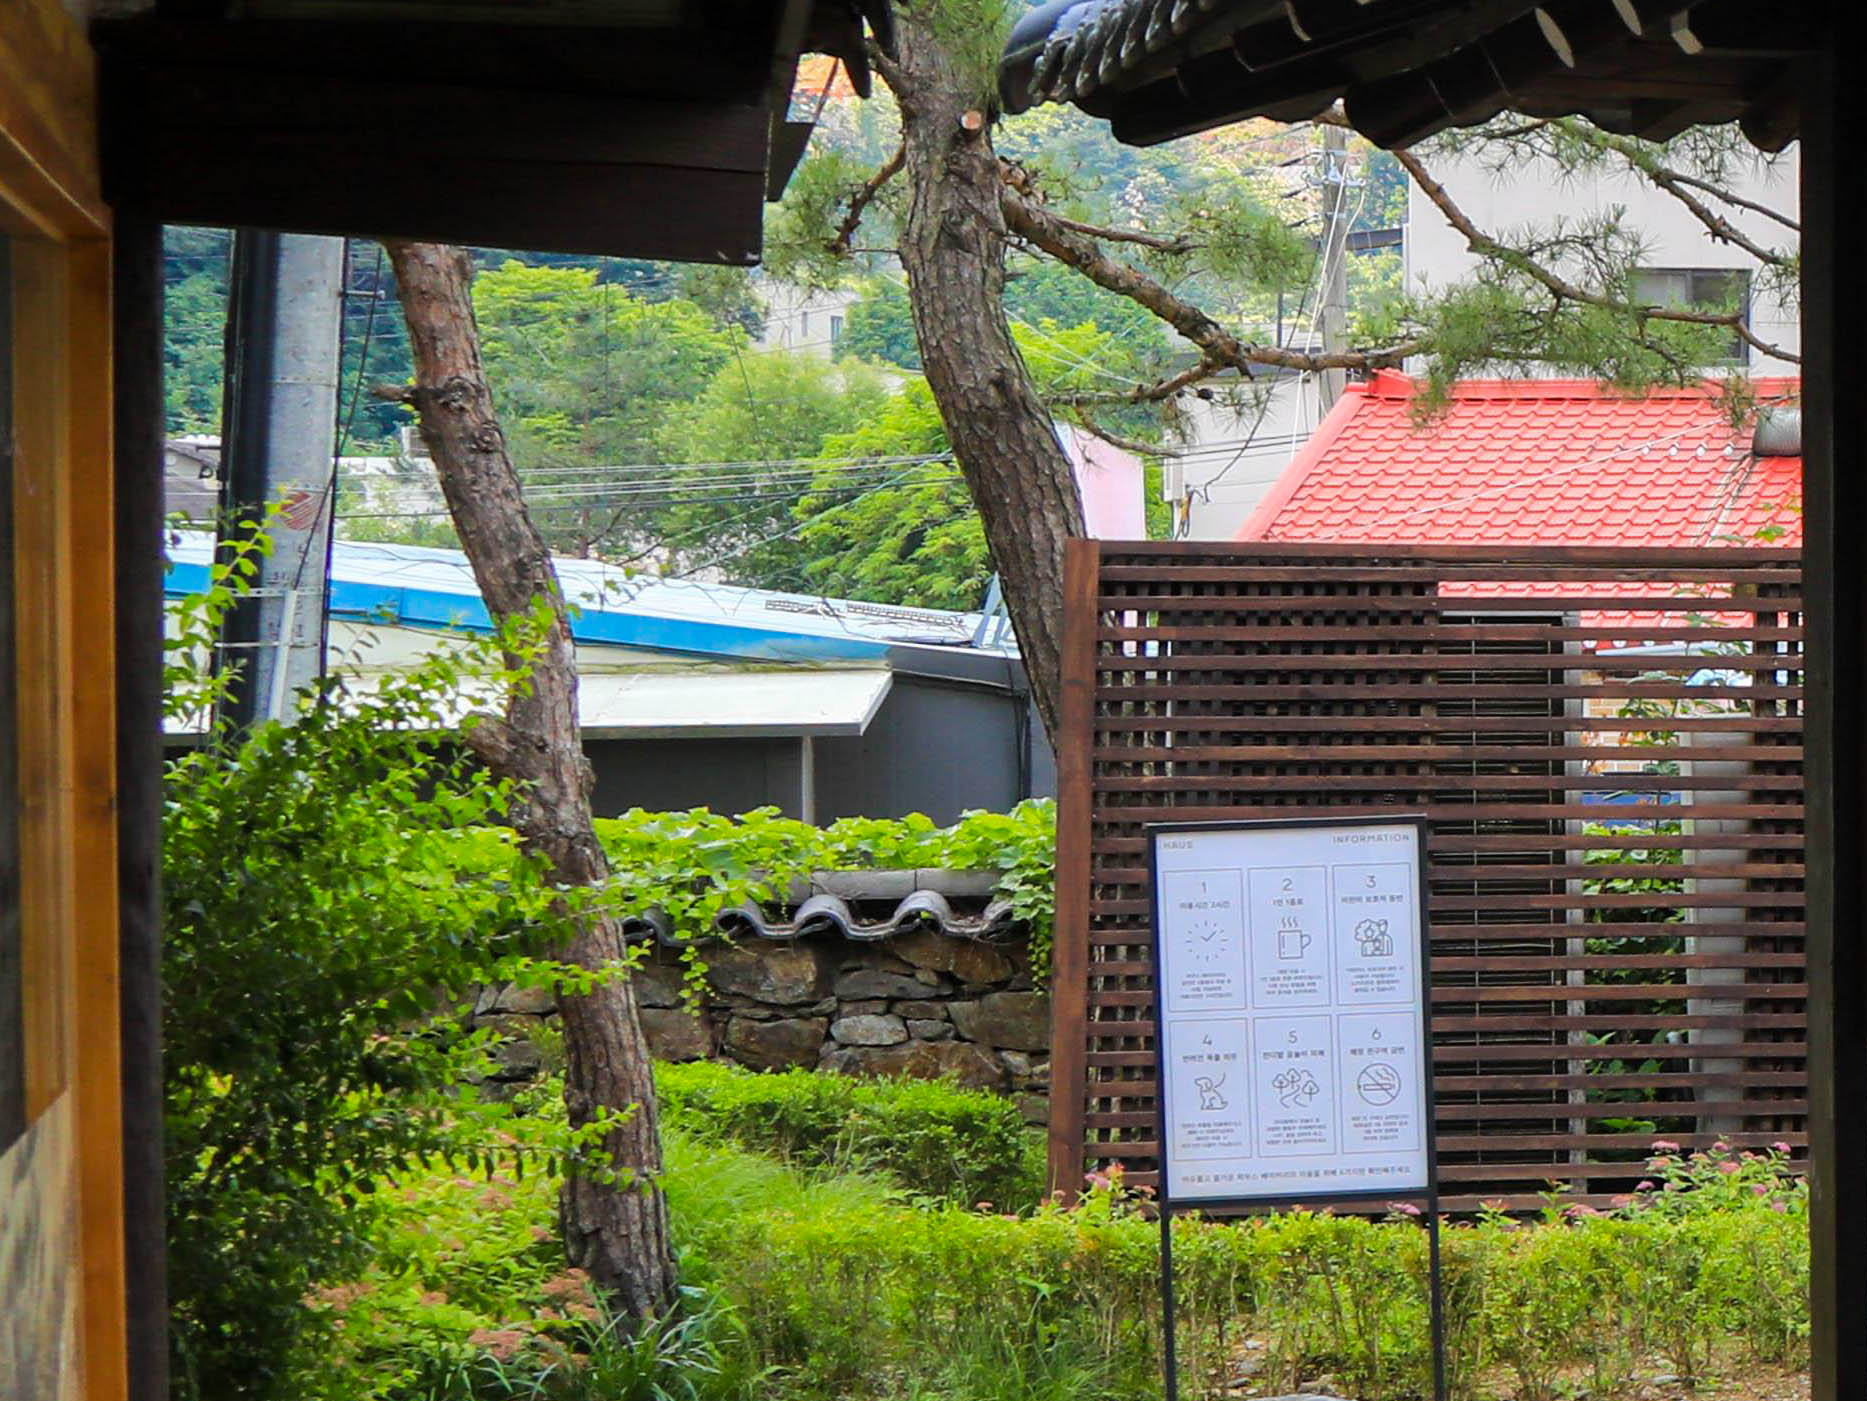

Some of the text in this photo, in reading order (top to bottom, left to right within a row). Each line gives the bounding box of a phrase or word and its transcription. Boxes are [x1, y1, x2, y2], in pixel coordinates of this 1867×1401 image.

[1333, 833, 1411, 845] INFORMATION
[1201, 881, 1207, 893] 1
[1282, 878, 1293, 891] 2
[1366, 875, 1377, 888] 3
[1202, 1033, 1213, 1046] 4
[1288, 1030, 1298, 1043] 5
[1371, 1028, 1382, 1040] 6
